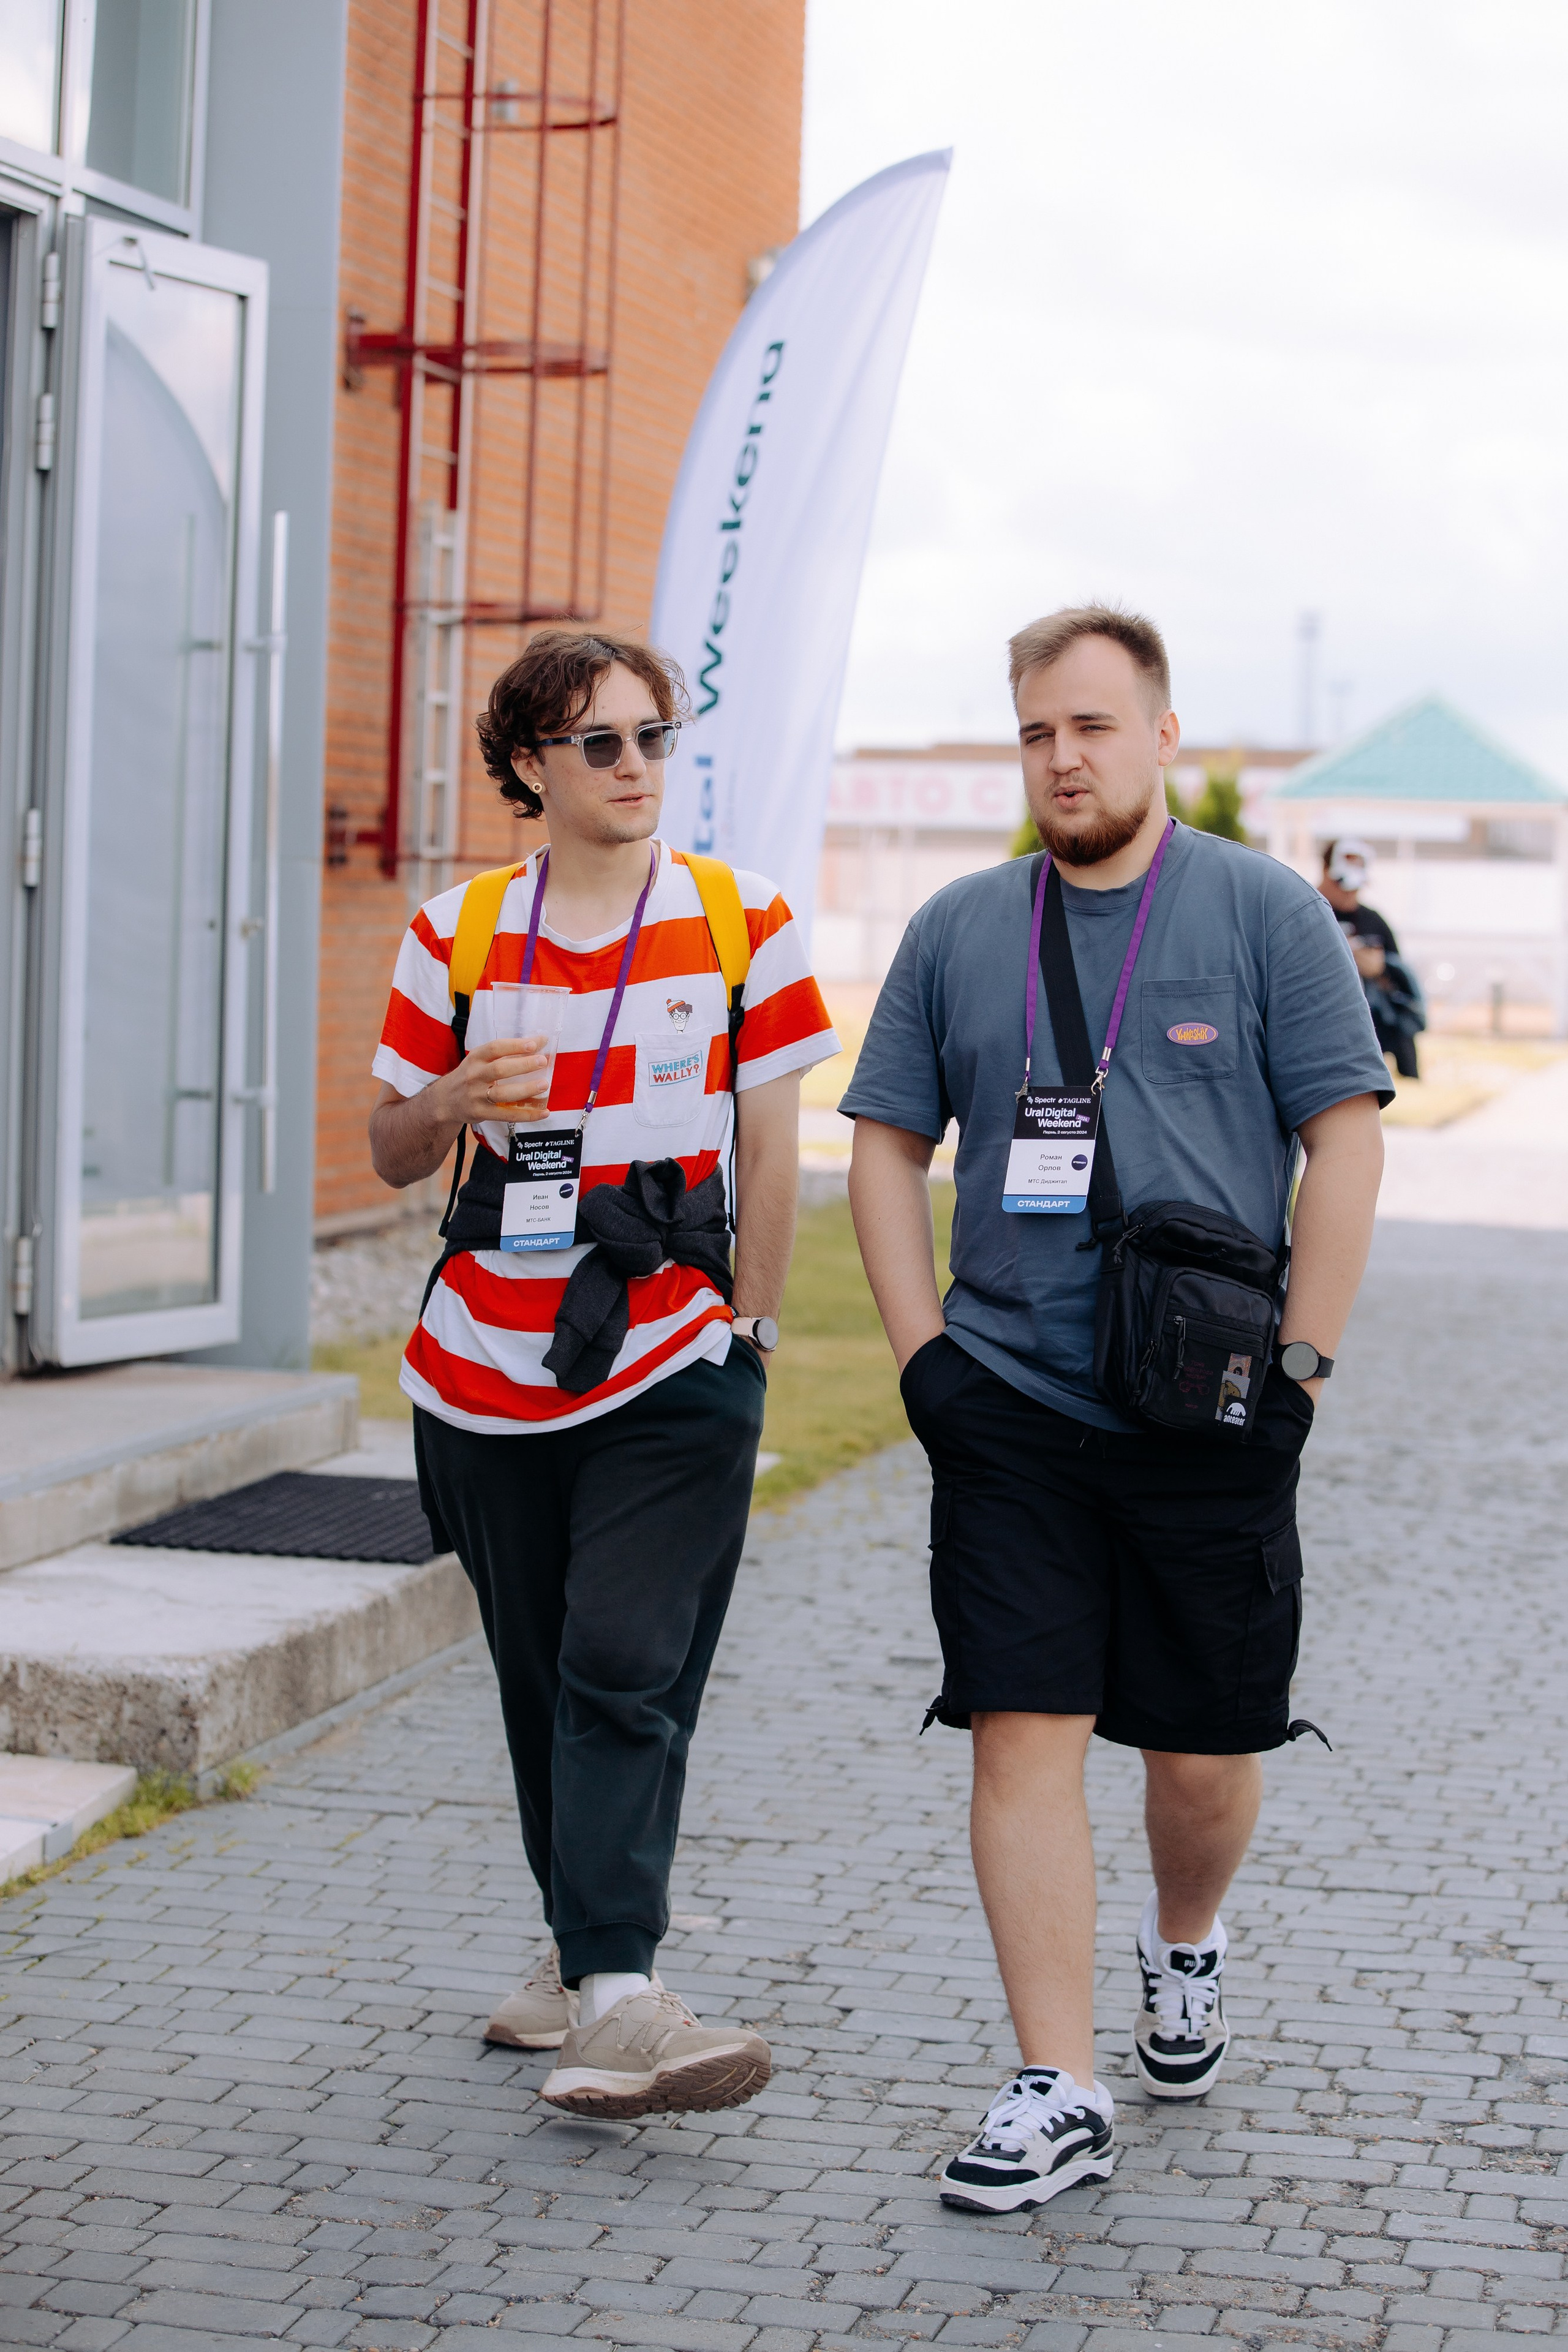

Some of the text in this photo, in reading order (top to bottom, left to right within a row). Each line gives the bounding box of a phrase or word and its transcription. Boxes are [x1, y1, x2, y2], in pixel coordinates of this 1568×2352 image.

[652, 1054, 699, 1074] WHERE'S
[653, 1064, 699, 1083] WALLY?
[1025, 1107, 1076, 1119] Ural Digital
[1038, 1118, 1082, 1128] Weekend
[516, 1150, 562, 1162] Ural Digital
[527, 1161, 567, 1170] Weekend
[513, 1237, 560, 1246] СТАНДАРТ
[1223, 1415, 1245, 1426] anteater
